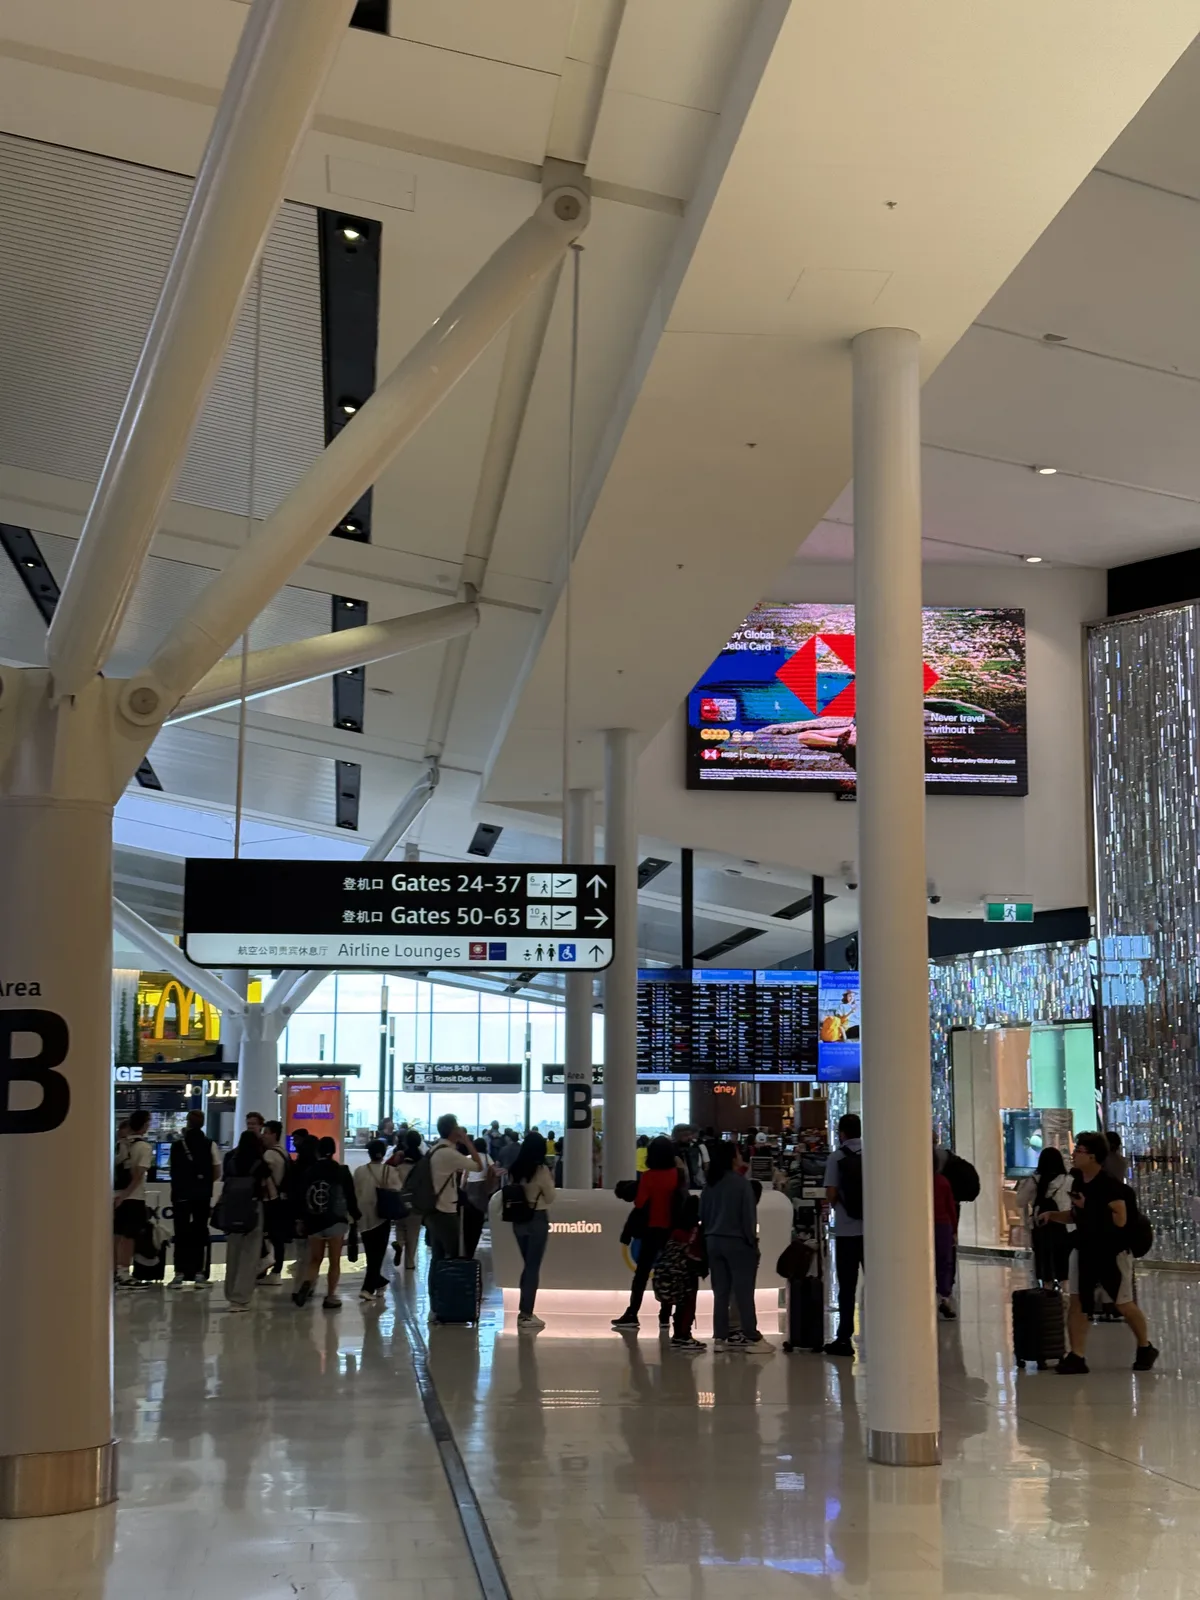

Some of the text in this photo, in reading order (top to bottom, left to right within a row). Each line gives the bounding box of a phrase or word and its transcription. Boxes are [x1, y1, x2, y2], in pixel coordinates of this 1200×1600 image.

[744, 630, 775, 639] Global
[749, 642, 771, 651] Card
[931, 713, 985, 722] Never travel
[931, 725, 975, 734] without it
[342, 877, 383, 891] 登机口
[391, 873, 521, 893] Gates 24-37
[341, 910, 383, 923] 登机口
[390, 906, 520, 926] Gates 50-63
[338, 943, 461, 961] Airline Lounges
[0, 1008, 71, 1134] B
[113, 1066, 143, 1082] GE
[568, 1072, 585, 1080] Area
[713, 1084, 737, 1096] dney
[567, 1083, 592, 1129] B
